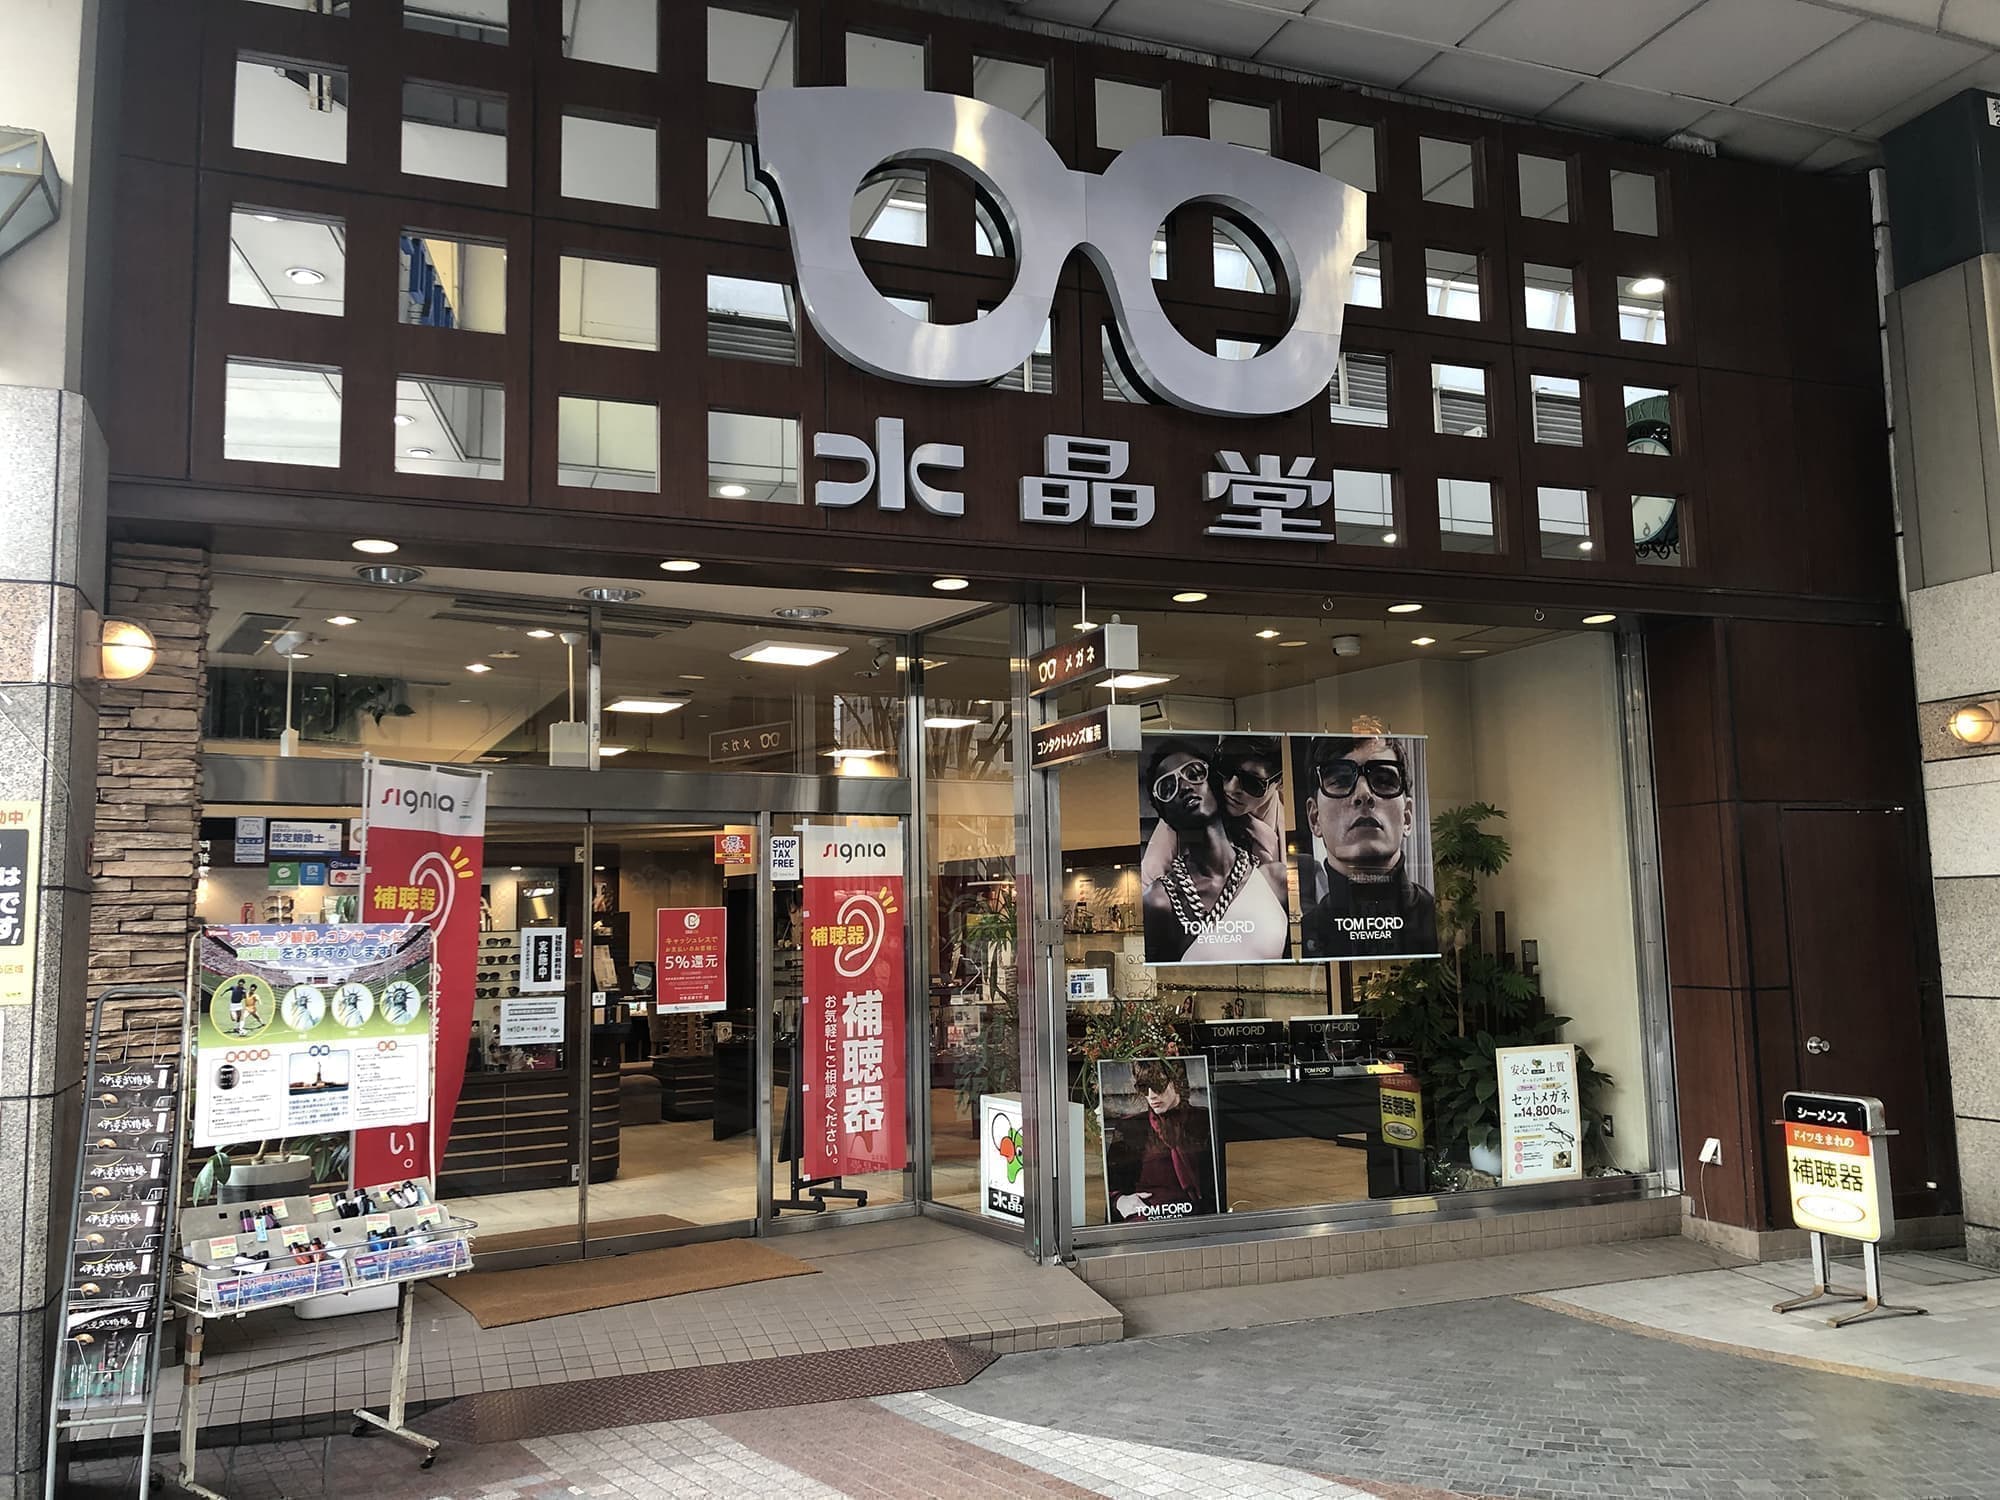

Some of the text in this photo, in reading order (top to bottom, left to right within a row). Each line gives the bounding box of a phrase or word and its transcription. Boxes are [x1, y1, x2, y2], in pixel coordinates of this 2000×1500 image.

[813, 416, 1335, 543] 水晶堂
[1065, 645, 1096, 672] メガネ
[1037, 723, 1103, 756] コンタクトレンズ販売
[381, 788, 455, 814] signia
[773, 839, 797, 849] SHOP
[773, 850, 791, 858] TAX
[823, 843, 886, 863] signia
[773, 859, 795, 868] FREE
[374, 885, 436, 911] 補聴器
[1182, 920, 1255, 935] TOM FORD
[1334, 917, 1404, 931] TOM FORD
[811, 926, 864, 946] 補聴器
[1197, 934, 1243, 944] EYEWEAR
[1350, 930, 1392, 940] EYEWEAR
[665, 955, 718, 970] 5%還元
[1211, 1025, 1265, 1037] TOM FORD
[1308, 1022, 1360, 1033] TOM FORD
[842, 989, 885, 1134] 補聴器
[824, 995, 839, 1165] お気軽にご相談ください。
[1511, 1089, 1570, 1106] セットメガネ
[1797, 1107, 1848, 1124] シーメンス
[1793, 1130, 1854, 1148] ドイツ生まれの
[1792, 1156, 1864, 1192] 補聴器
[1136, 1202, 1192, 1217] TOM FORD
